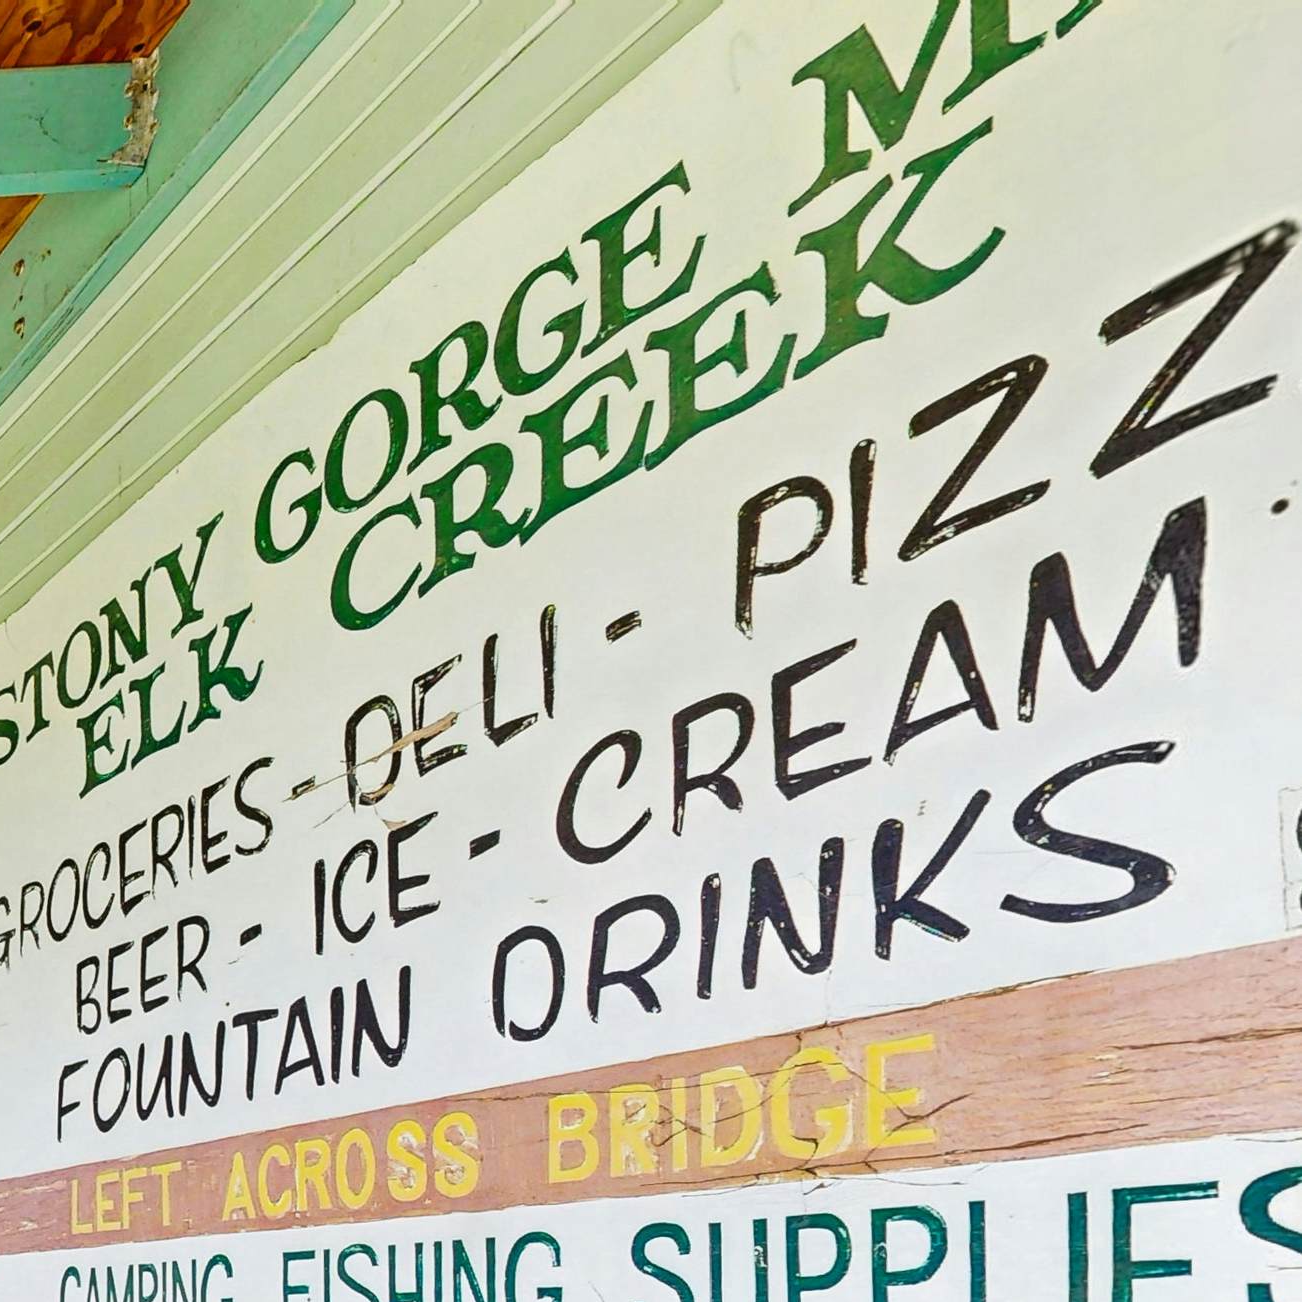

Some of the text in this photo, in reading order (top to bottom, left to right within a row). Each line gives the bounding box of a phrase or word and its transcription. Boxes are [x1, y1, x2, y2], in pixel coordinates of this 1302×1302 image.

[77, 117, 1005, 799] ELK CREEK
[254, 160, 706, 563] GORGE
[788, 0, 1102, 217] M
[345, 605, 558, 812] DELI
[735, 220, 1300, 636] PIZZ
[58, 966, 412, 1143] FOUNTAIN
[493, 741, 1177, 1041] DRINKS
[77, 916, 211, 1034] BEER
[314, 812, 441, 955] ICE
[556, 496, 1208, 864] CREAM
[70, 1033, 936, 1235] LEFT ACROSS BRIDGE
